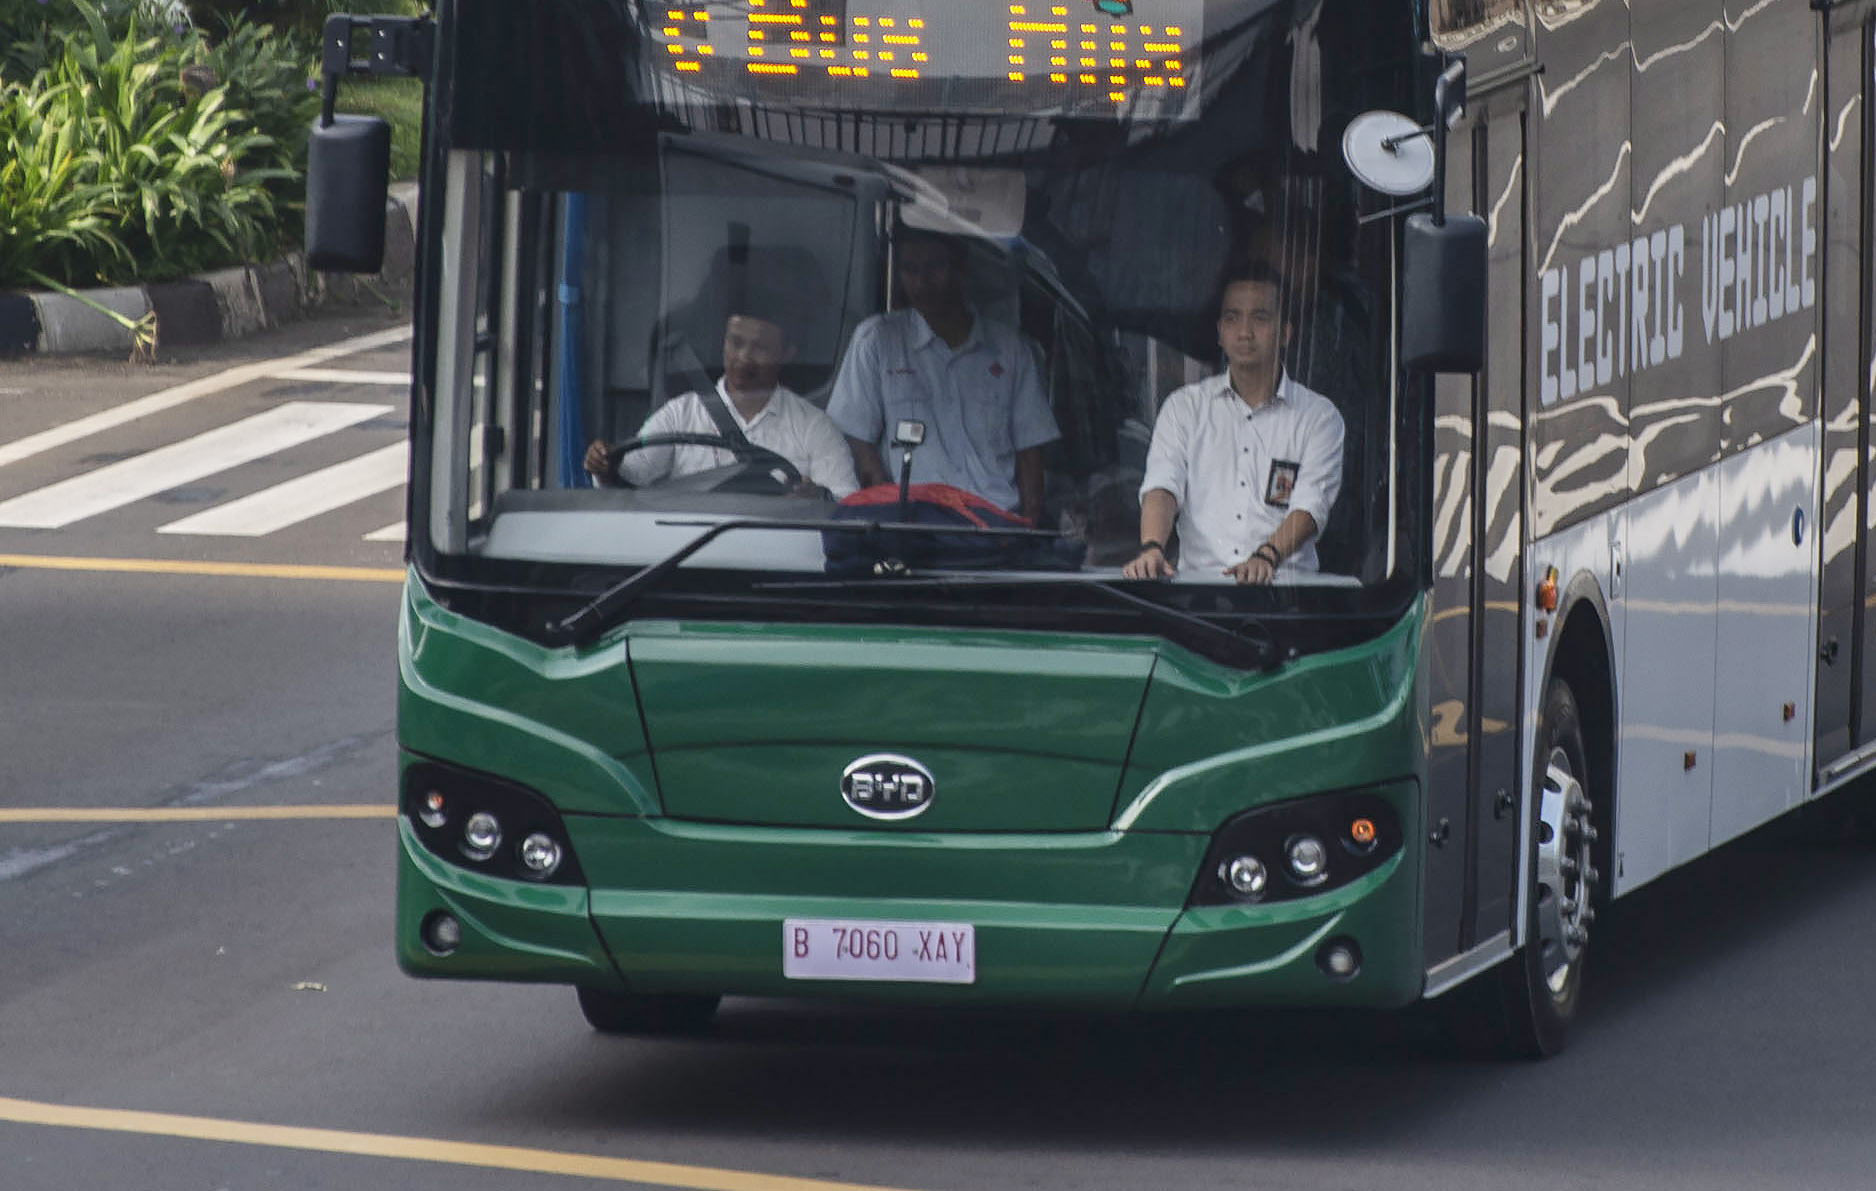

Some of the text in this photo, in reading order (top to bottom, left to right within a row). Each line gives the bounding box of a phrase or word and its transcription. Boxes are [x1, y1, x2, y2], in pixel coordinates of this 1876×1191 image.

[1540, 175, 1816, 407] ELECTRIC VEHICLE
[851, 773, 924, 803] BYD
[793, 927, 966, 964] B 7060 XAY
